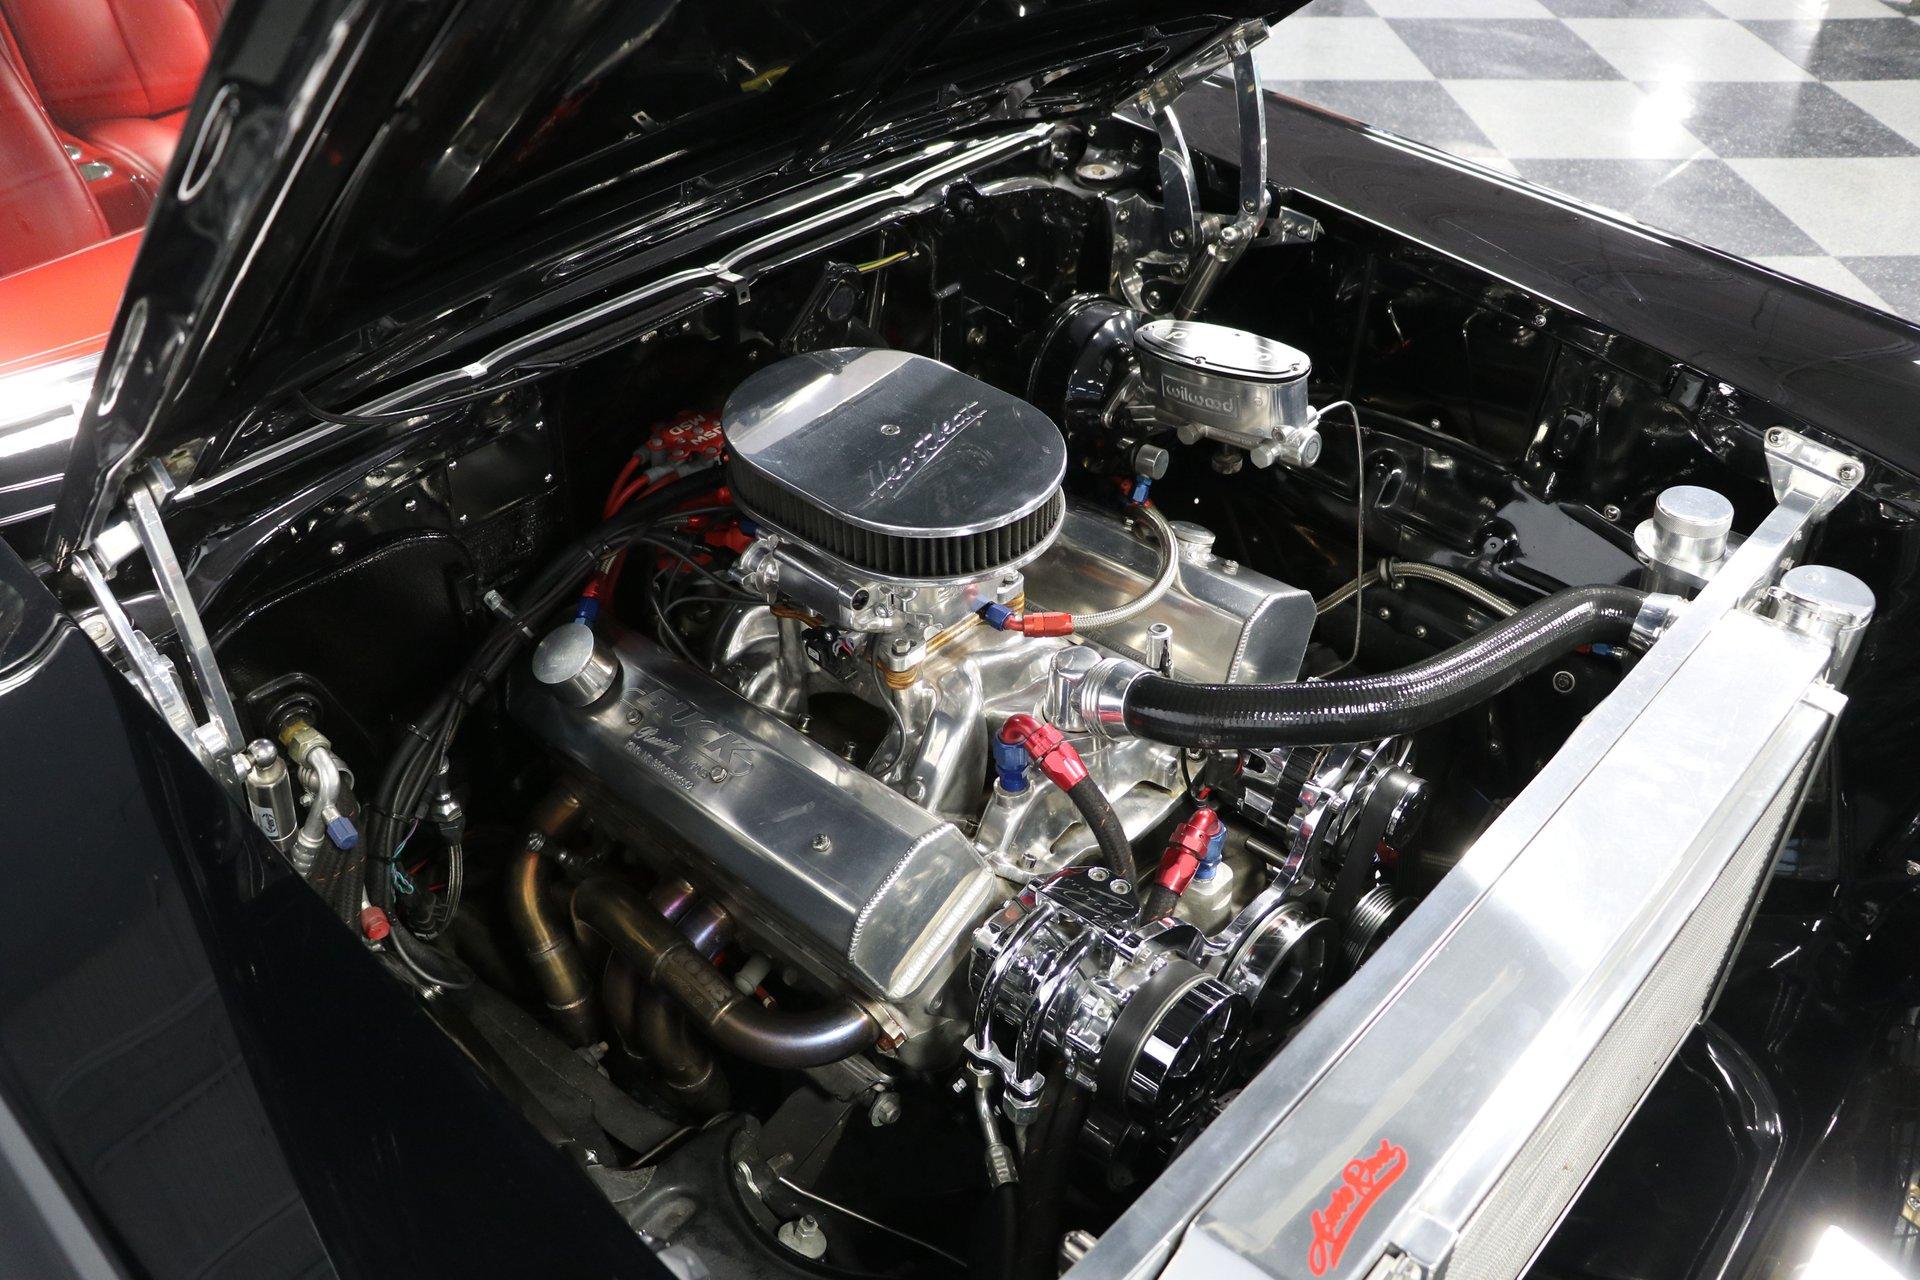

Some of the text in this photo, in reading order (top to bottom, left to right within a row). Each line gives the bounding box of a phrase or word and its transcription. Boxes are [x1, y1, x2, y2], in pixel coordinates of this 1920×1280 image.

[1166, 385, 1233, 413] wilwood
[669, 415, 706, 435] MSD
[869, 400, 985, 499] Heartbeat
[637, 689, 755, 764] BUCK
